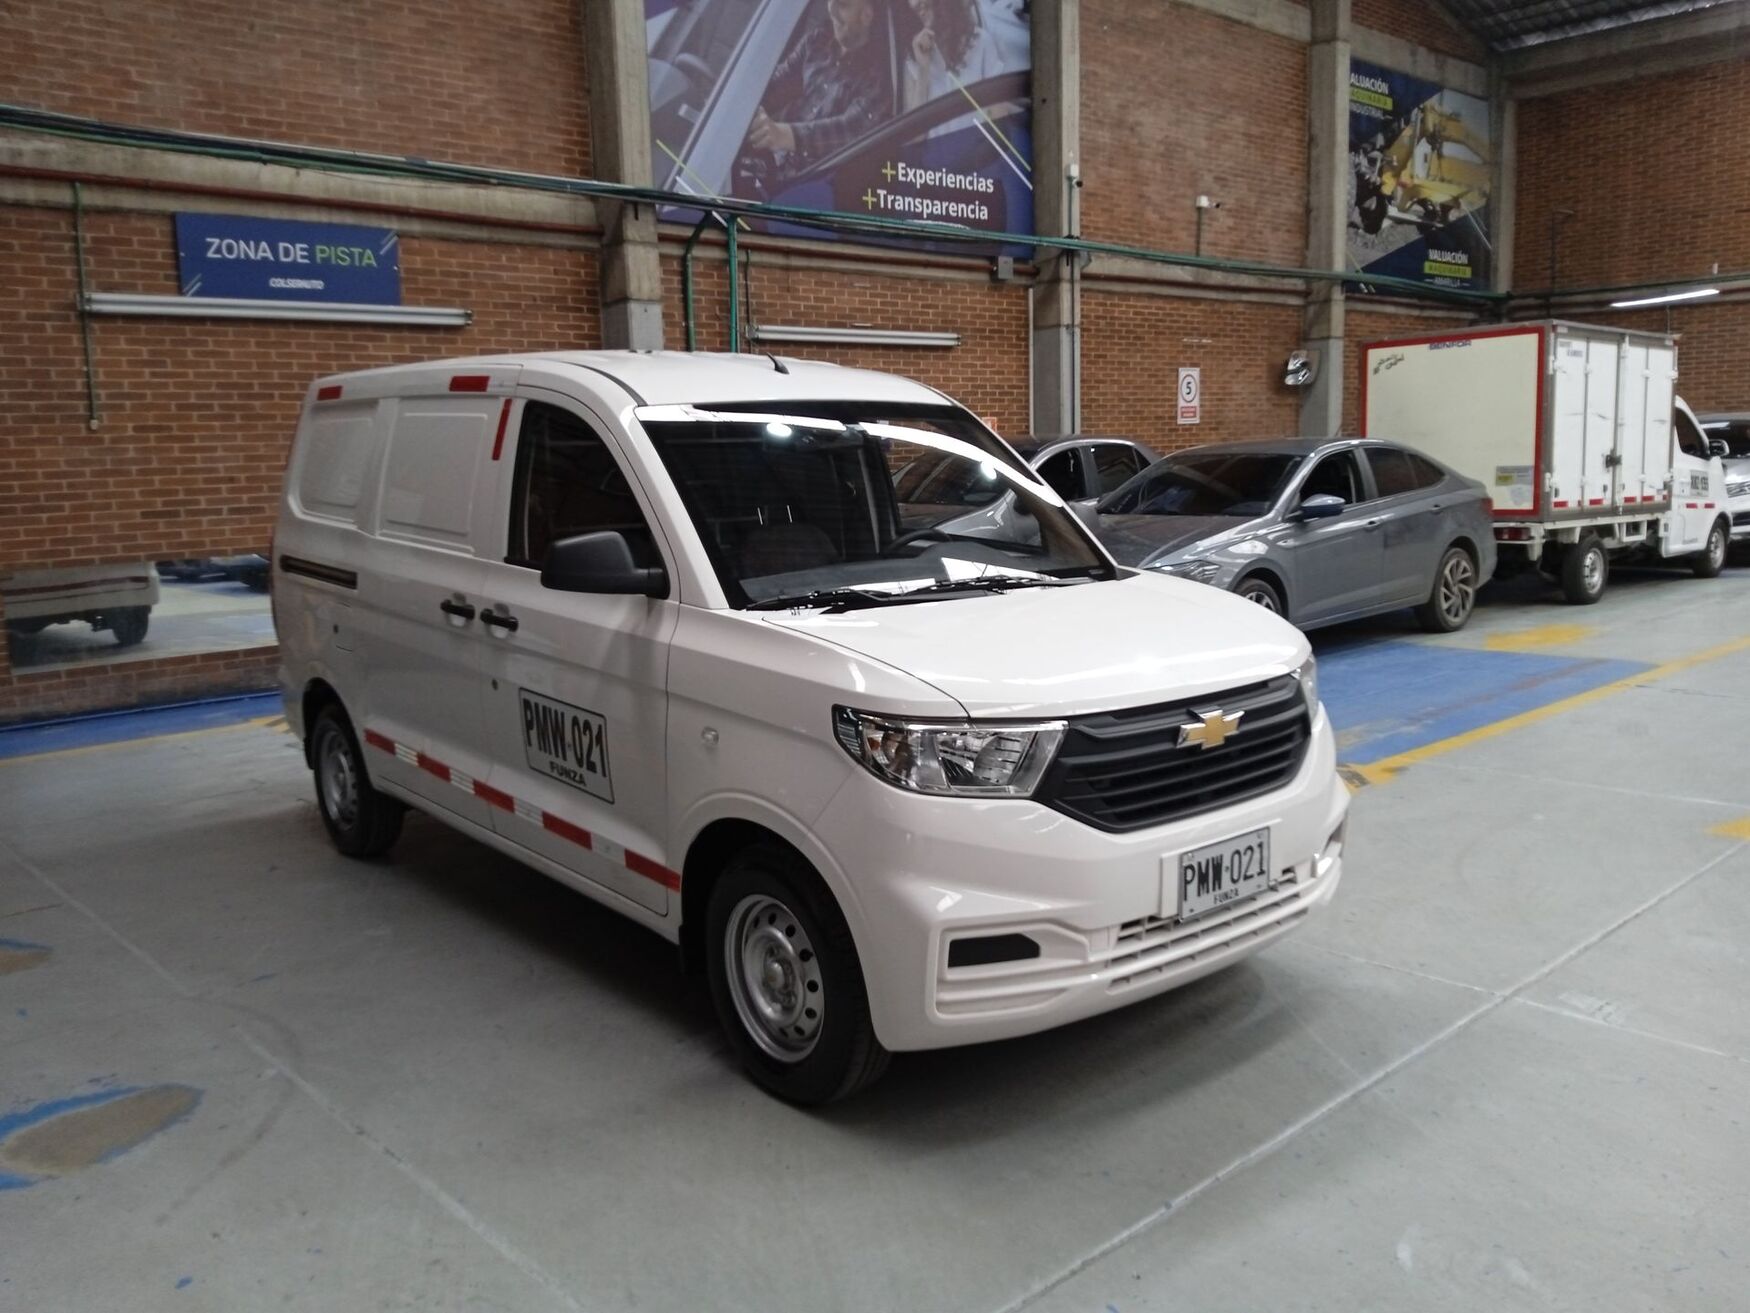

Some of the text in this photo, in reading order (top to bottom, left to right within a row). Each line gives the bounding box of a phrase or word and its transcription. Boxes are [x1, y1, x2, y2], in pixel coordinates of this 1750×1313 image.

[1349, 72, 1389, 95] ALUACIÓN
[882, 161, 995, 194] +Experiencias
[862, 188, 989, 220] +Transparencia
[206, 237, 378, 268] ZONA DE PISTA
[1185, 381, 1193, 396] 5
[548, 760, 588, 788] FUNZA
